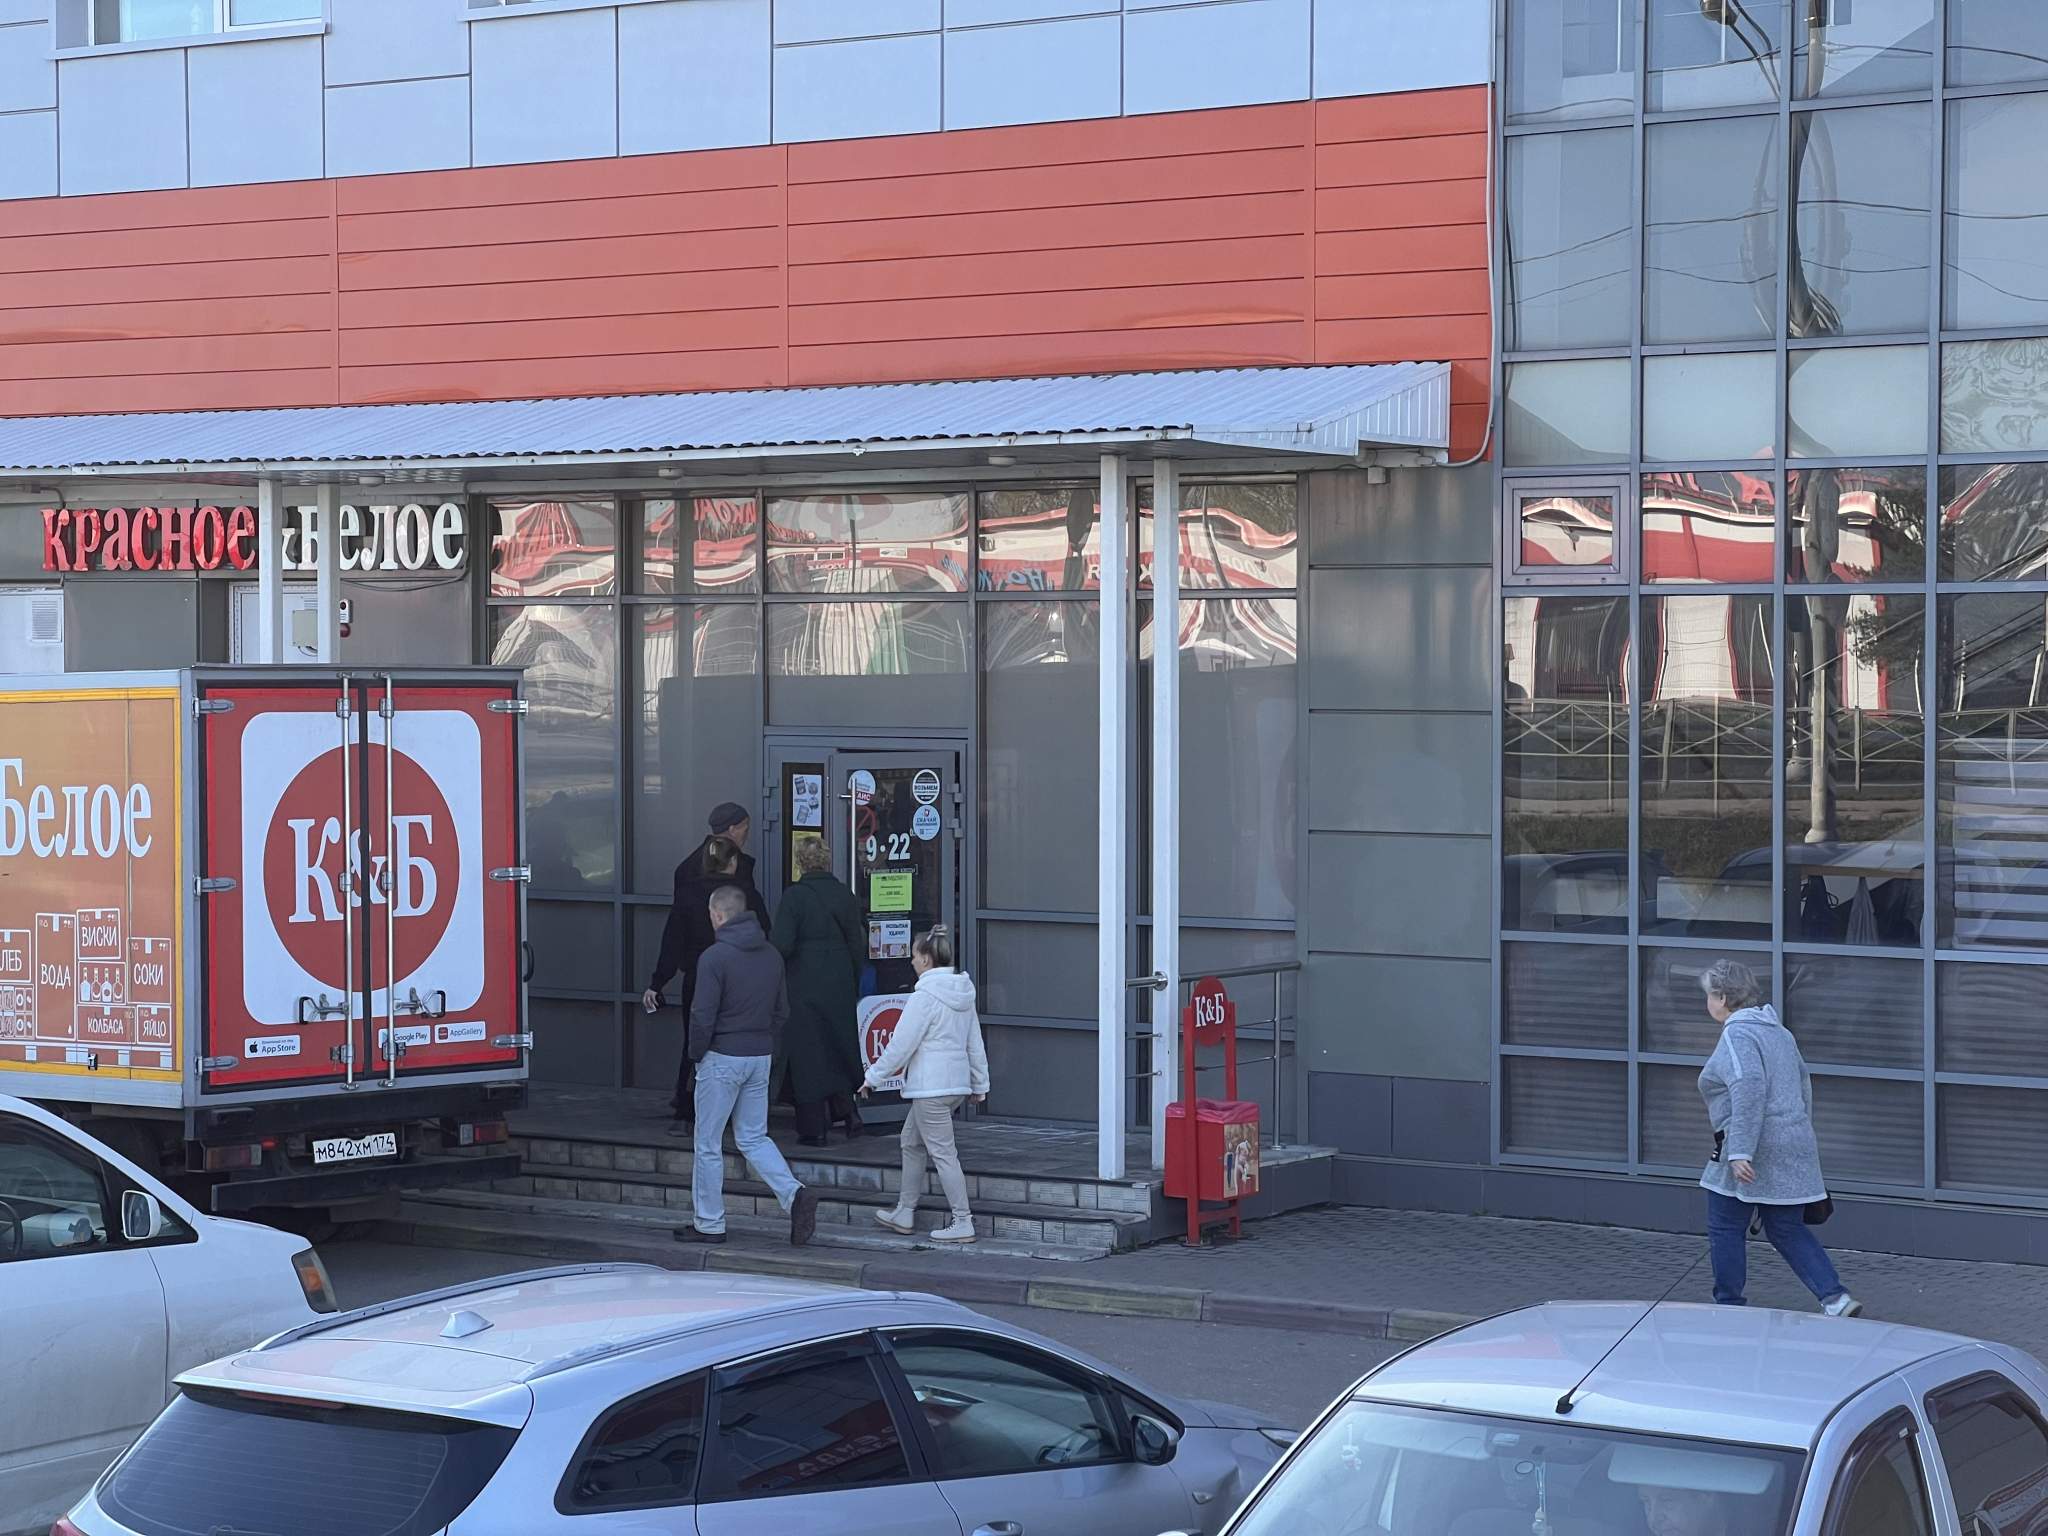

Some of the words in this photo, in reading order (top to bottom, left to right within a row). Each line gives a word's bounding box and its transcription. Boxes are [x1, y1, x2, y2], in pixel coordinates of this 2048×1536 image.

[0, 757, 153, 859] Белое
[287, 814, 438, 923] К&Б
[81, 926, 118, 947] ВИСКИ
[40, 963, 71, 990] ВОДА
[133, 963, 164, 987] СОКИ
[1194, 993, 1225, 1028] К&Б
[87, 1017, 124, 1035] КОЛБАСА
[142, 1018, 167, 1038] ЯЙЦО
[449, 1028, 483, 1037] AppGallery
[394, 1033, 415, 1042] Google
[415, 1032, 428, 1041] Play
[261, 1045, 277, 1055] App
[277, 1044, 296, 1052] Store
[373, 1136, 395, 1150] 174
